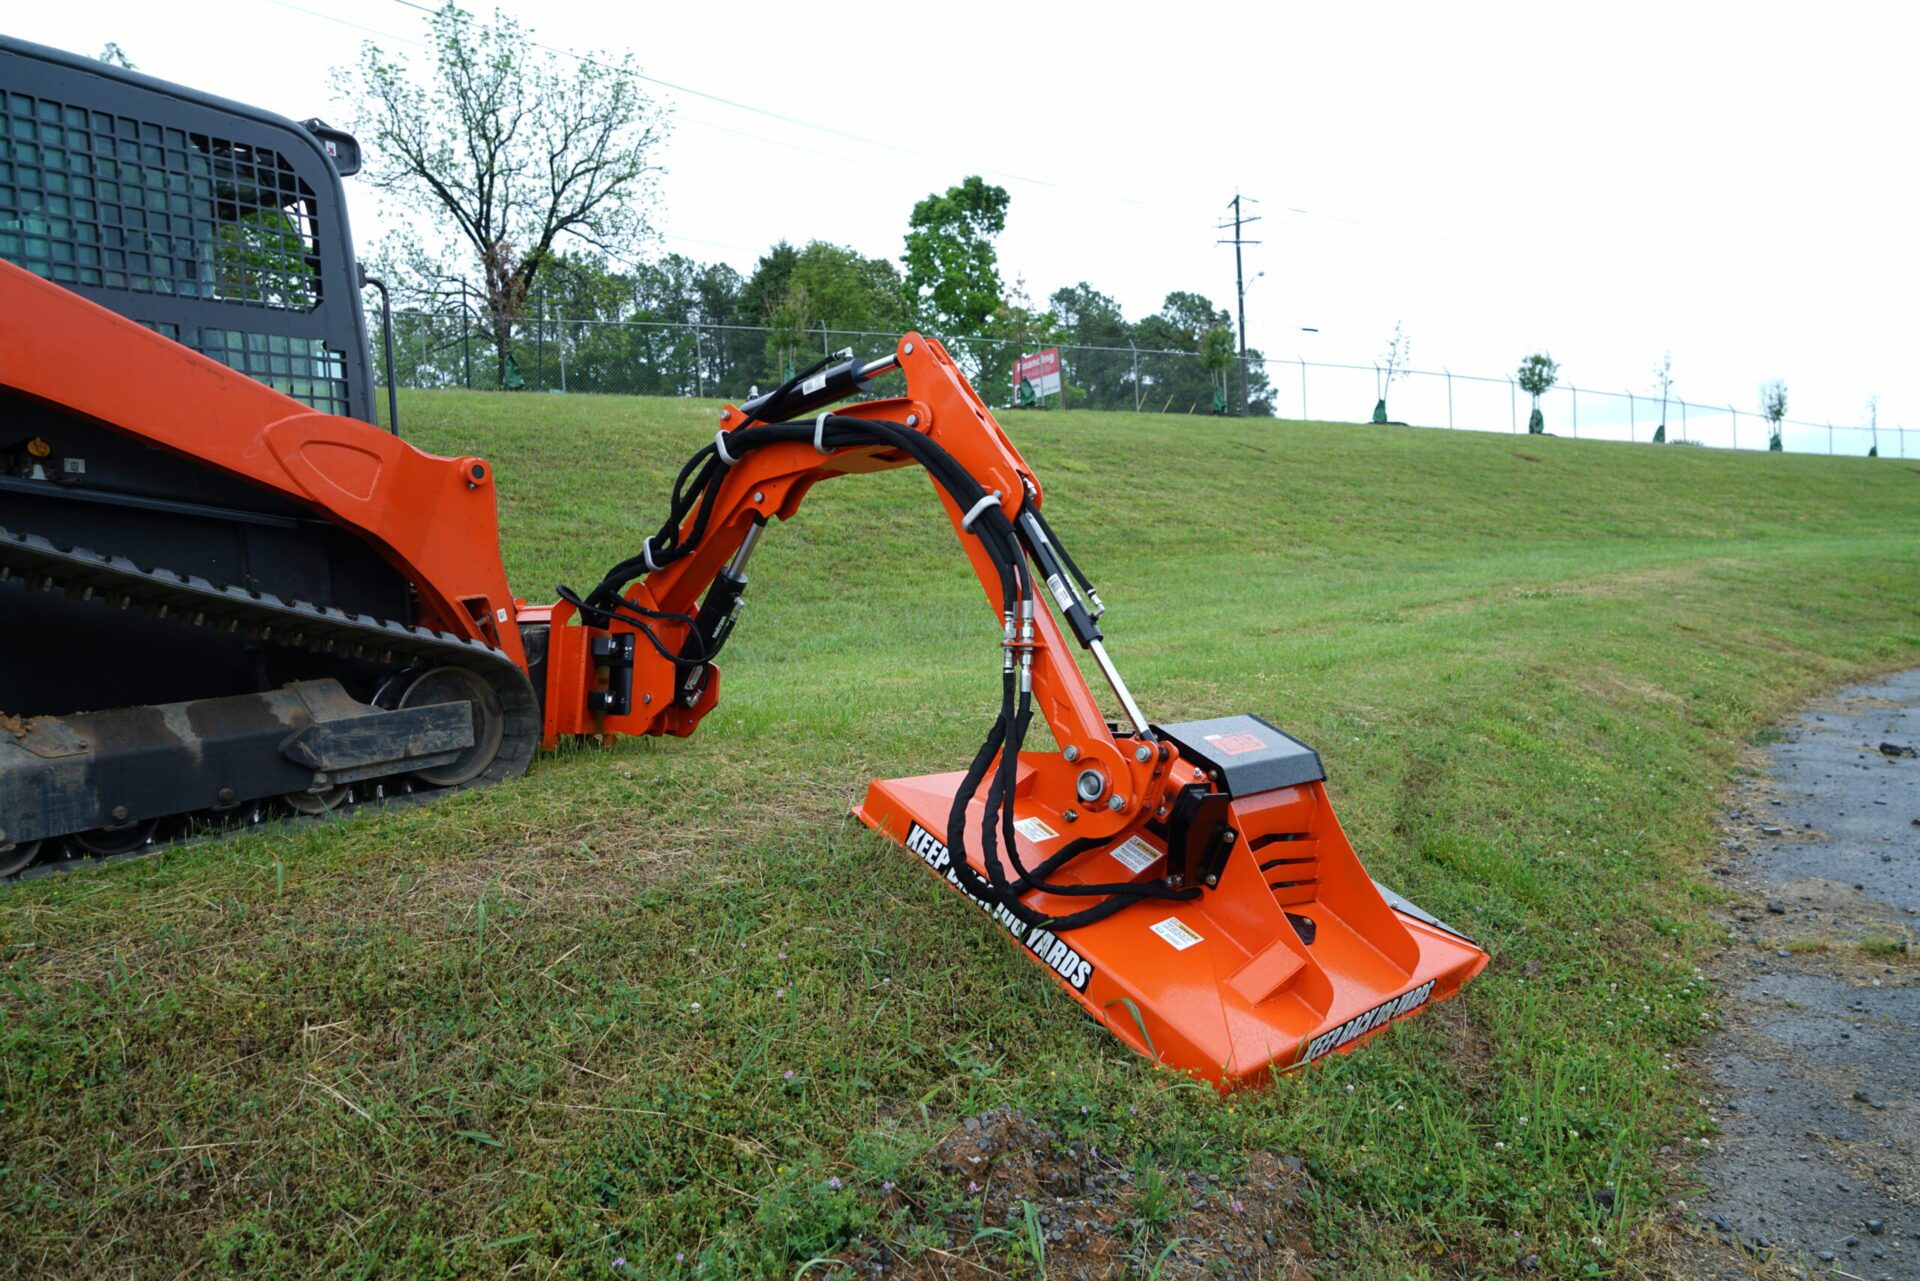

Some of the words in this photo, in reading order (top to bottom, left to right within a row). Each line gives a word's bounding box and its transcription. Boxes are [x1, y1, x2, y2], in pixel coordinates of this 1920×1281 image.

[906, 824, 950, 870] KEEP
[1026, 928, 1092, 988] YARDS
[1301, 1026, 1343, 1062] KEEP
